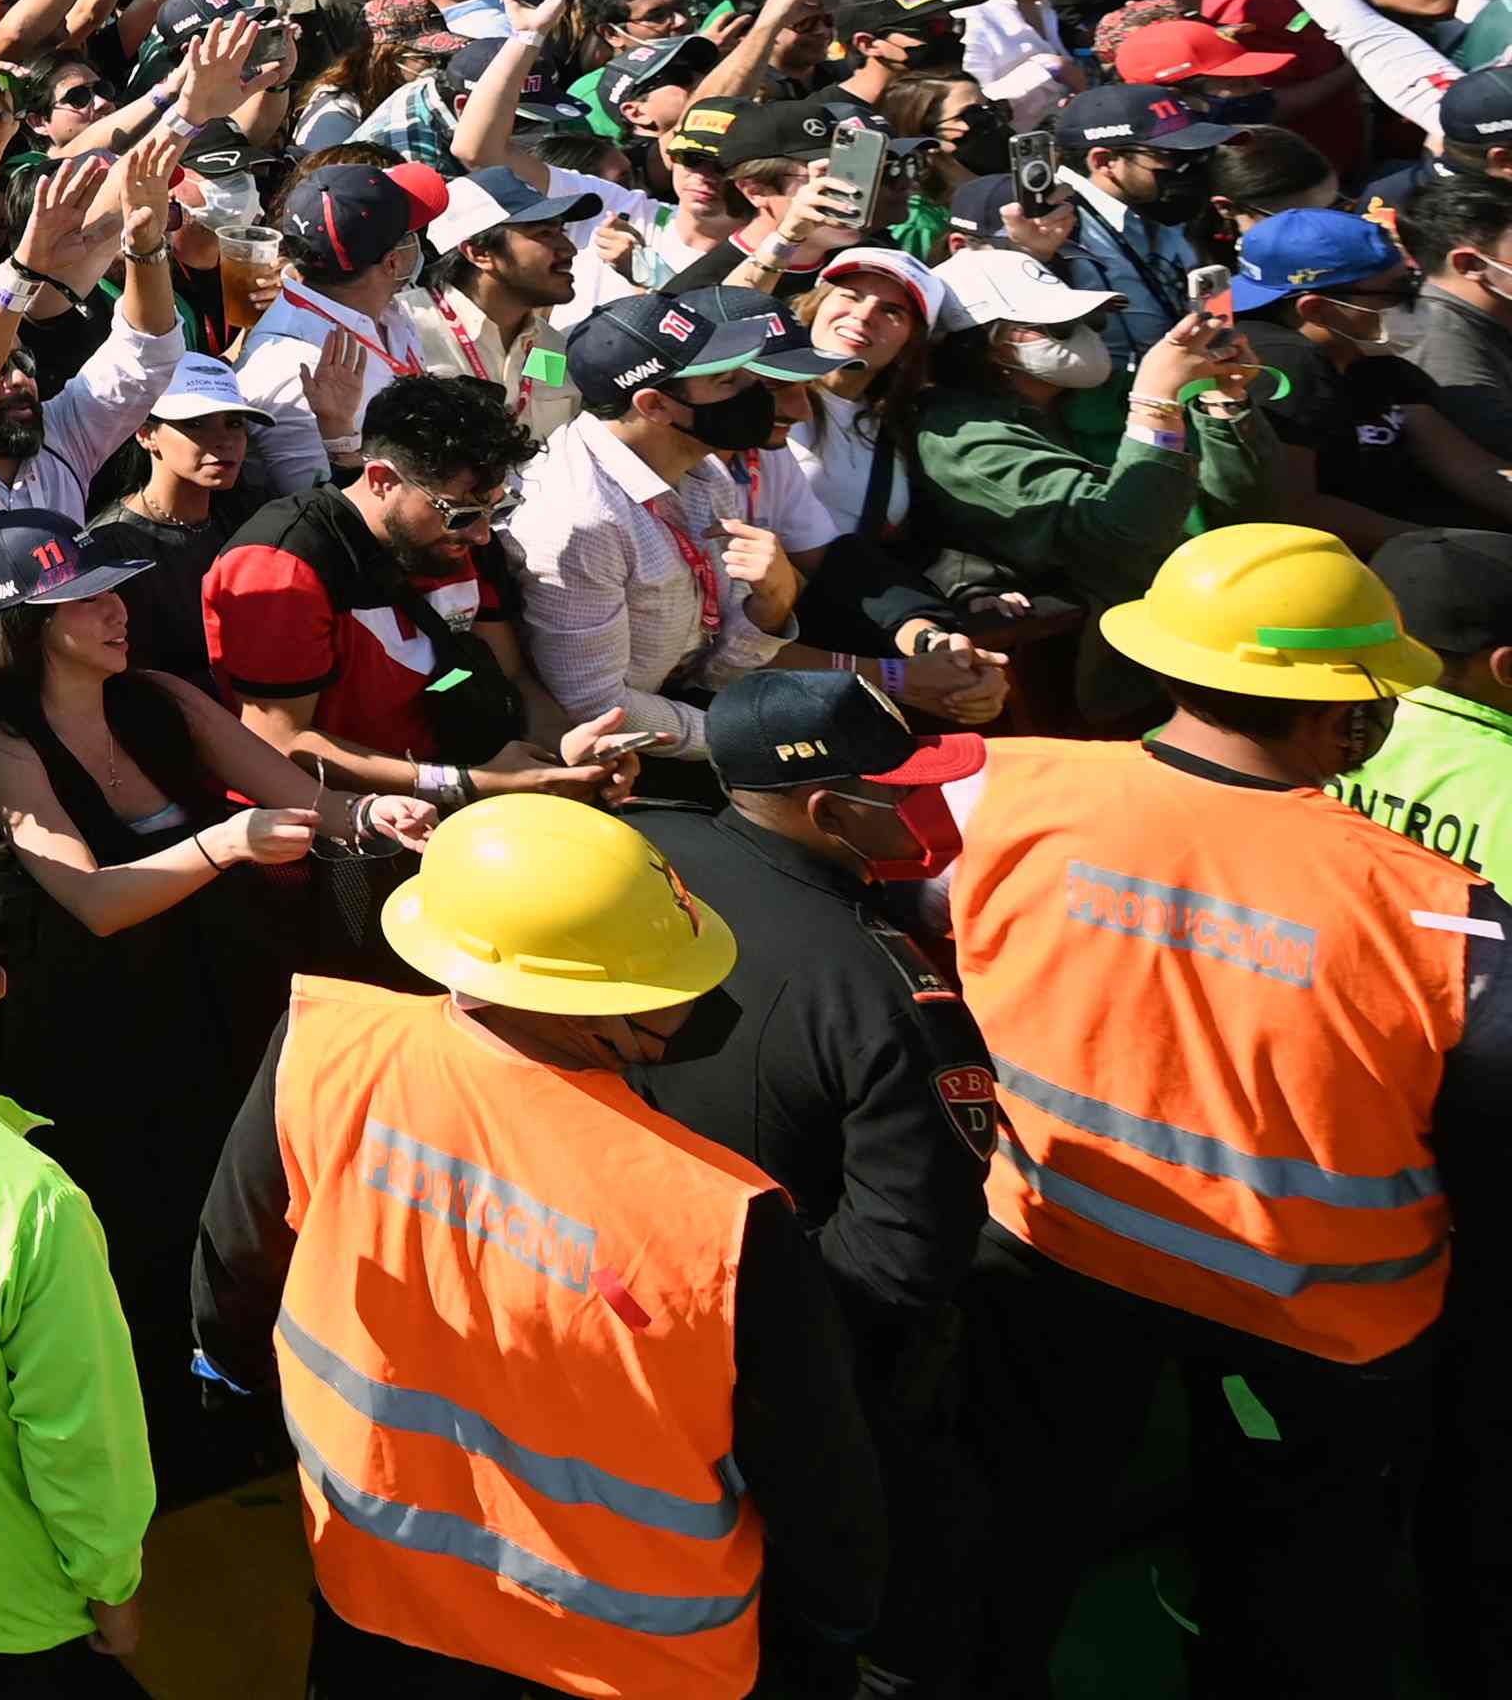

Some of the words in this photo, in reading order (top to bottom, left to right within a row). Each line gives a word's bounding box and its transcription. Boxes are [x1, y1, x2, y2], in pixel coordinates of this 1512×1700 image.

[659, 308, 696, 342] 11
[613, 356, 666, 391] KAVAK
[32, 540, 66, 572] 11
[775, 740, 829, 763] PBI
[1323, 780, 1484, 875] ONTROL
[1073, 881, 1314, 980] PRODUCCIÓN
[968, 1108, 988, 1134] D
[367, 1136, 591, 1284] PRODUCCIÓN
